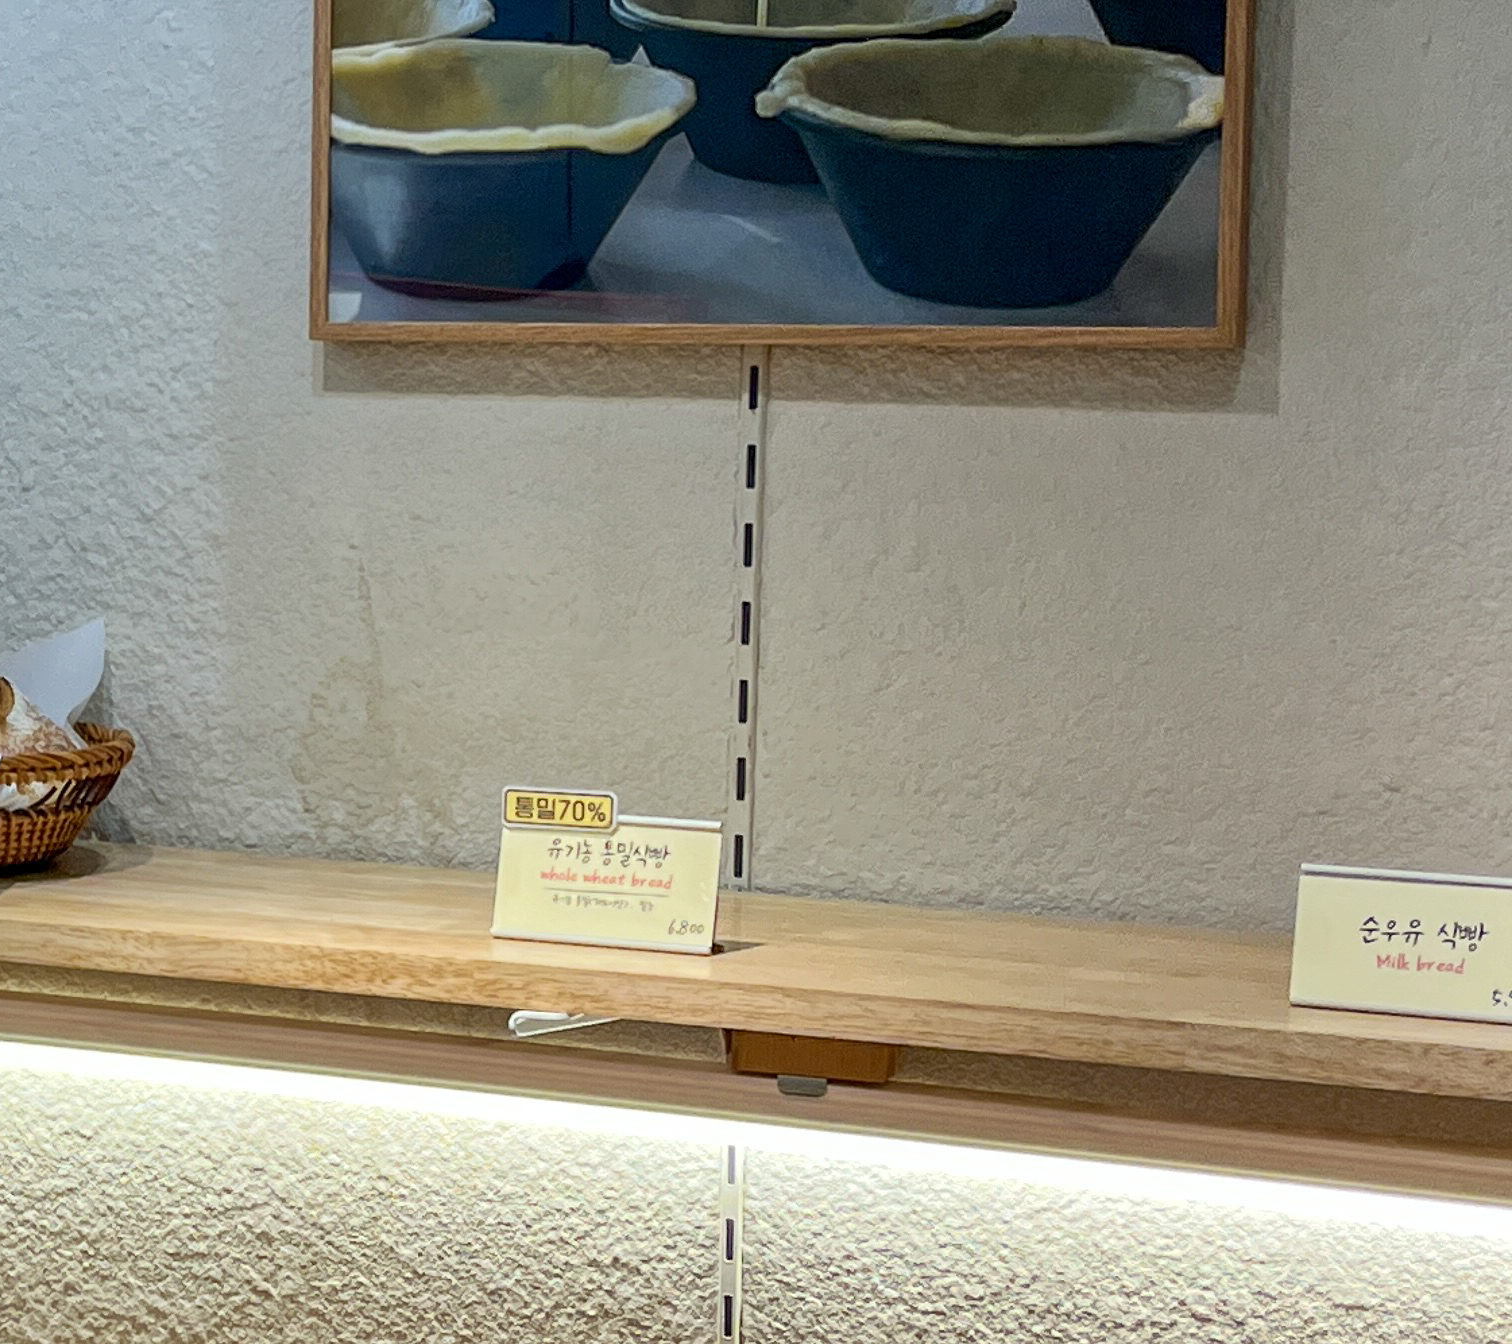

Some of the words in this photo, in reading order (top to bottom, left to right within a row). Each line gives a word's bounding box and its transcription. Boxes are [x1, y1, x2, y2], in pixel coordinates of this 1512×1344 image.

[514, 795, 607, 823] 통밀70%
[547, 837, 593, 864] 유기농
[540, 865, 578, 882] whole
[583, 868, 626, 886] wheat
[631, 871, 673, 890] bread
[1359, 916, 1425, 947] 순우유
[1437, 921, 1491, 953] 식빵
[1376, 953, 1410, 971] Milk
[1416, 954, 1466, 975] bread
